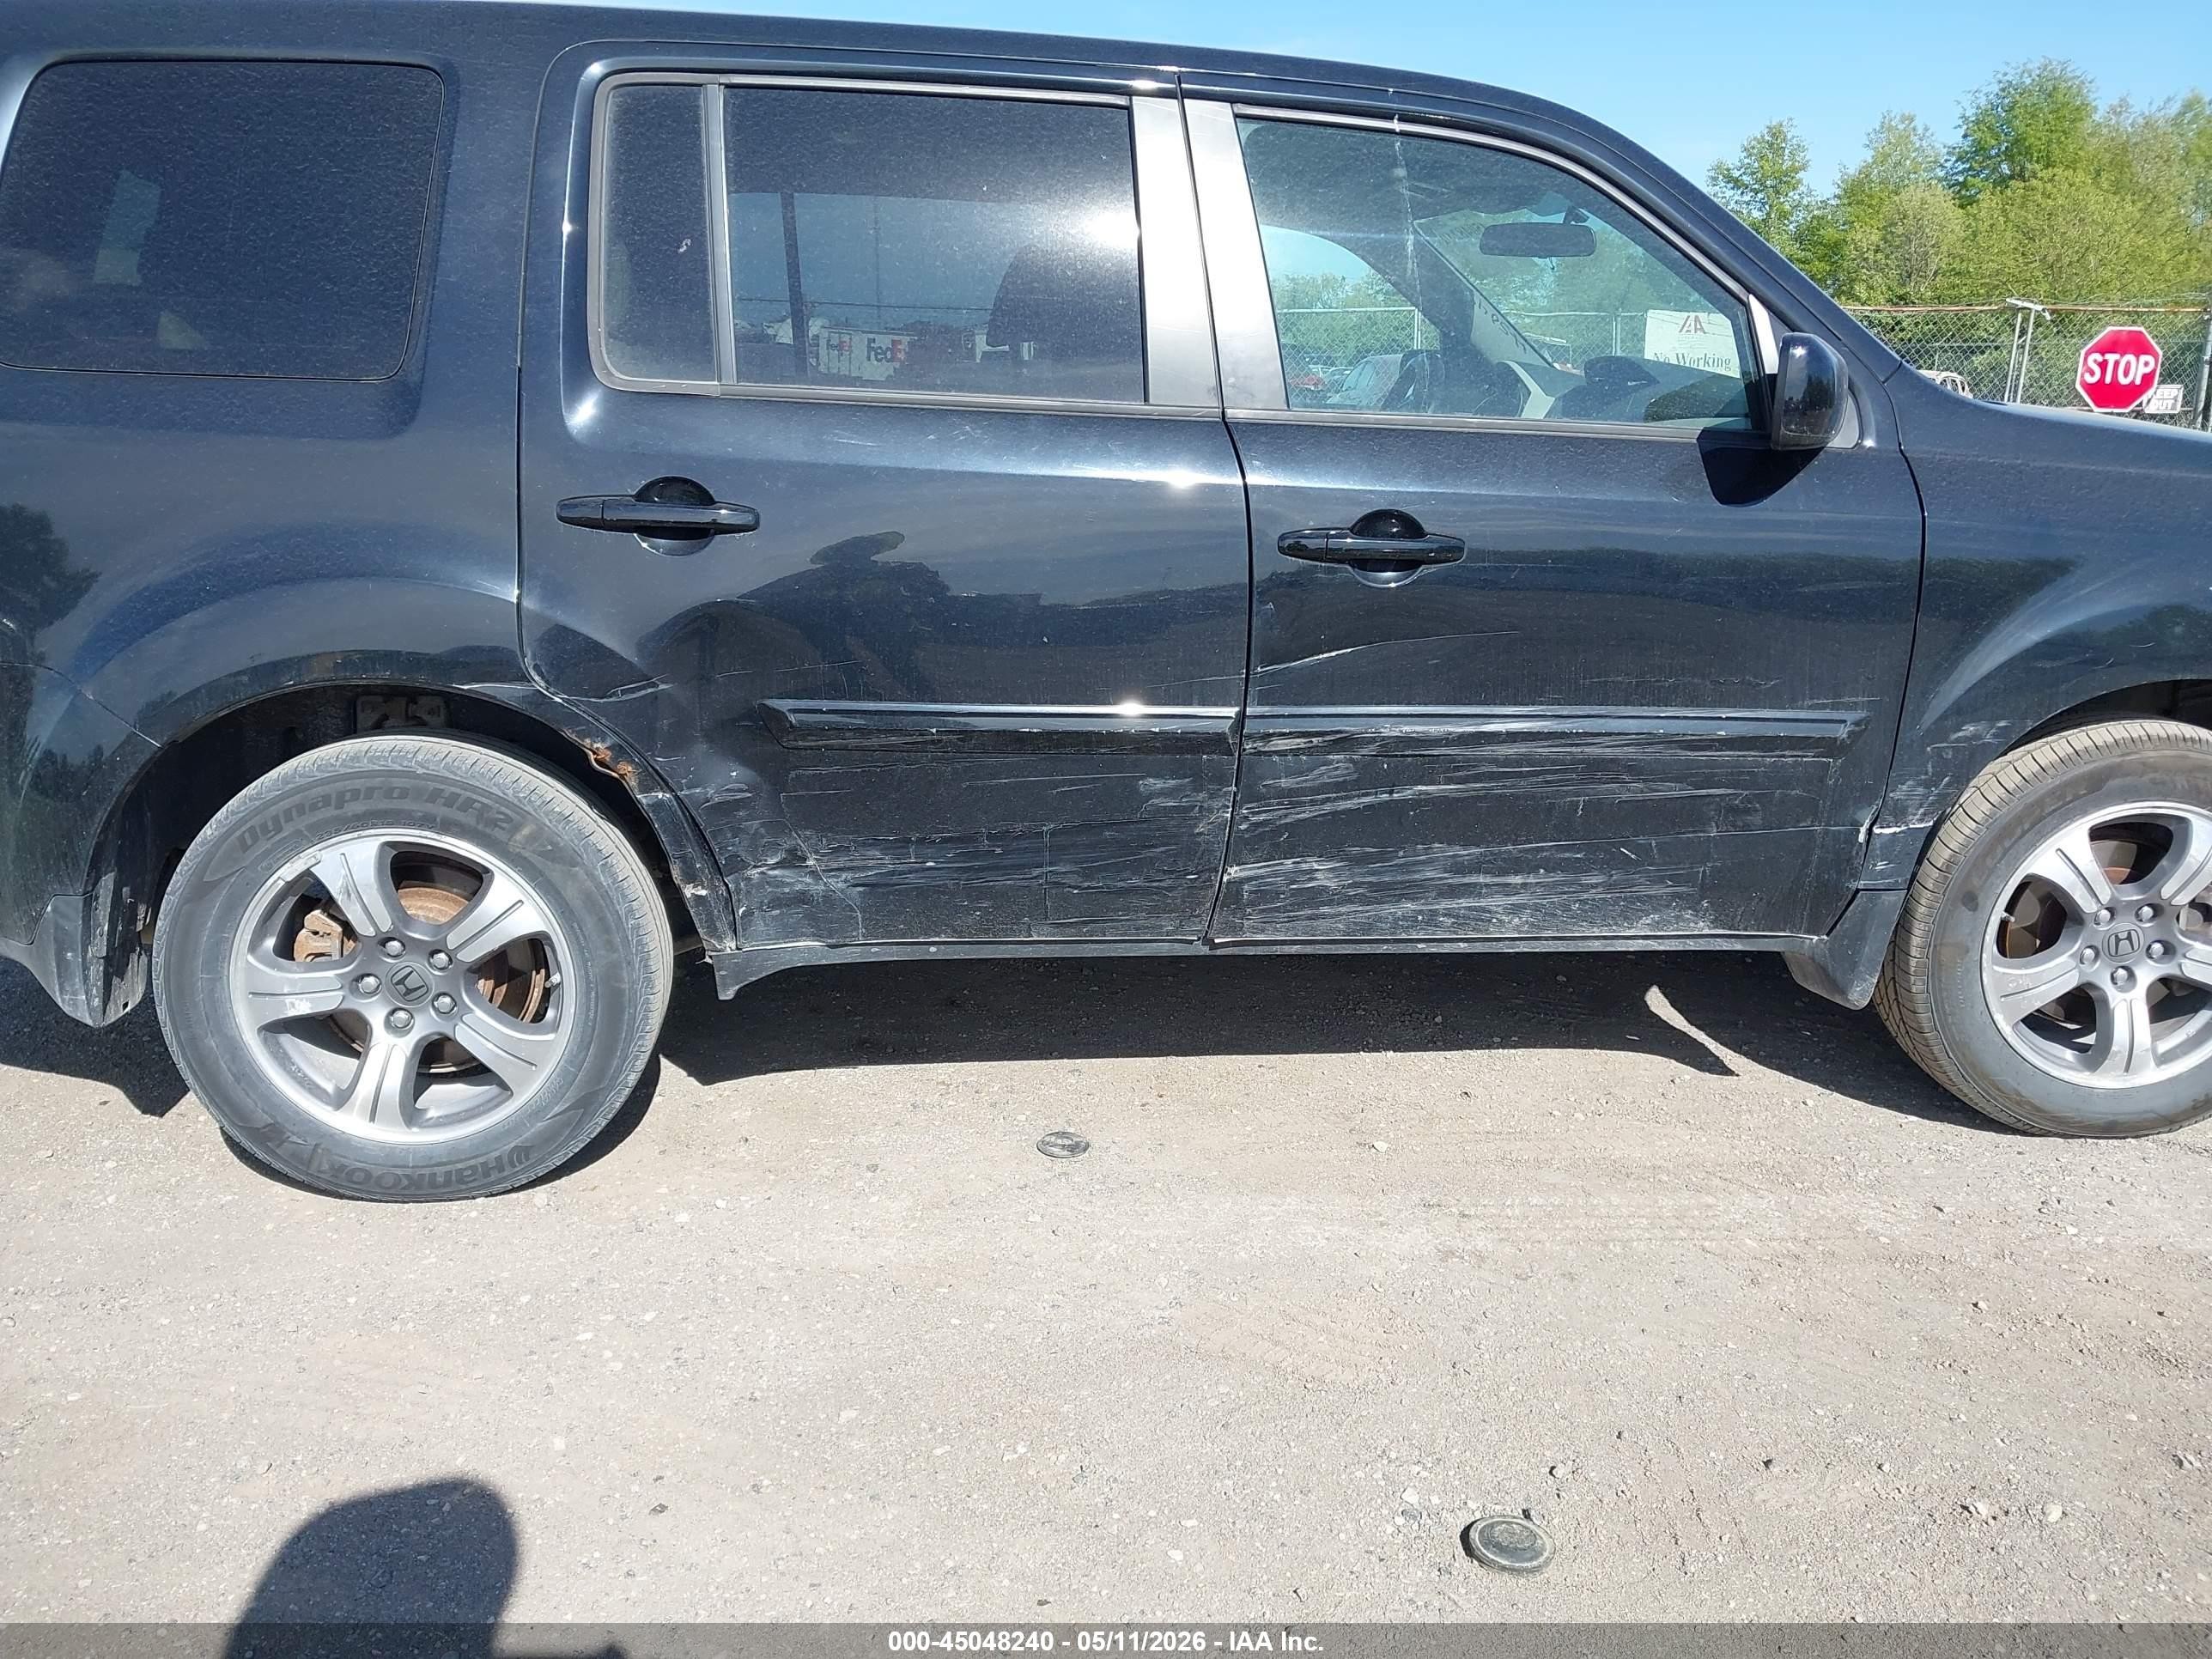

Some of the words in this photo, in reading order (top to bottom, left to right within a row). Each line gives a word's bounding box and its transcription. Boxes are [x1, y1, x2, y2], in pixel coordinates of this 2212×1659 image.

[1675, 352, 1732, 371] Working
[2083, 352, 2155, 386] STOP
[2153, 389, 2179, 398] EEP
[236, 785, 410, 852] Dynapro
